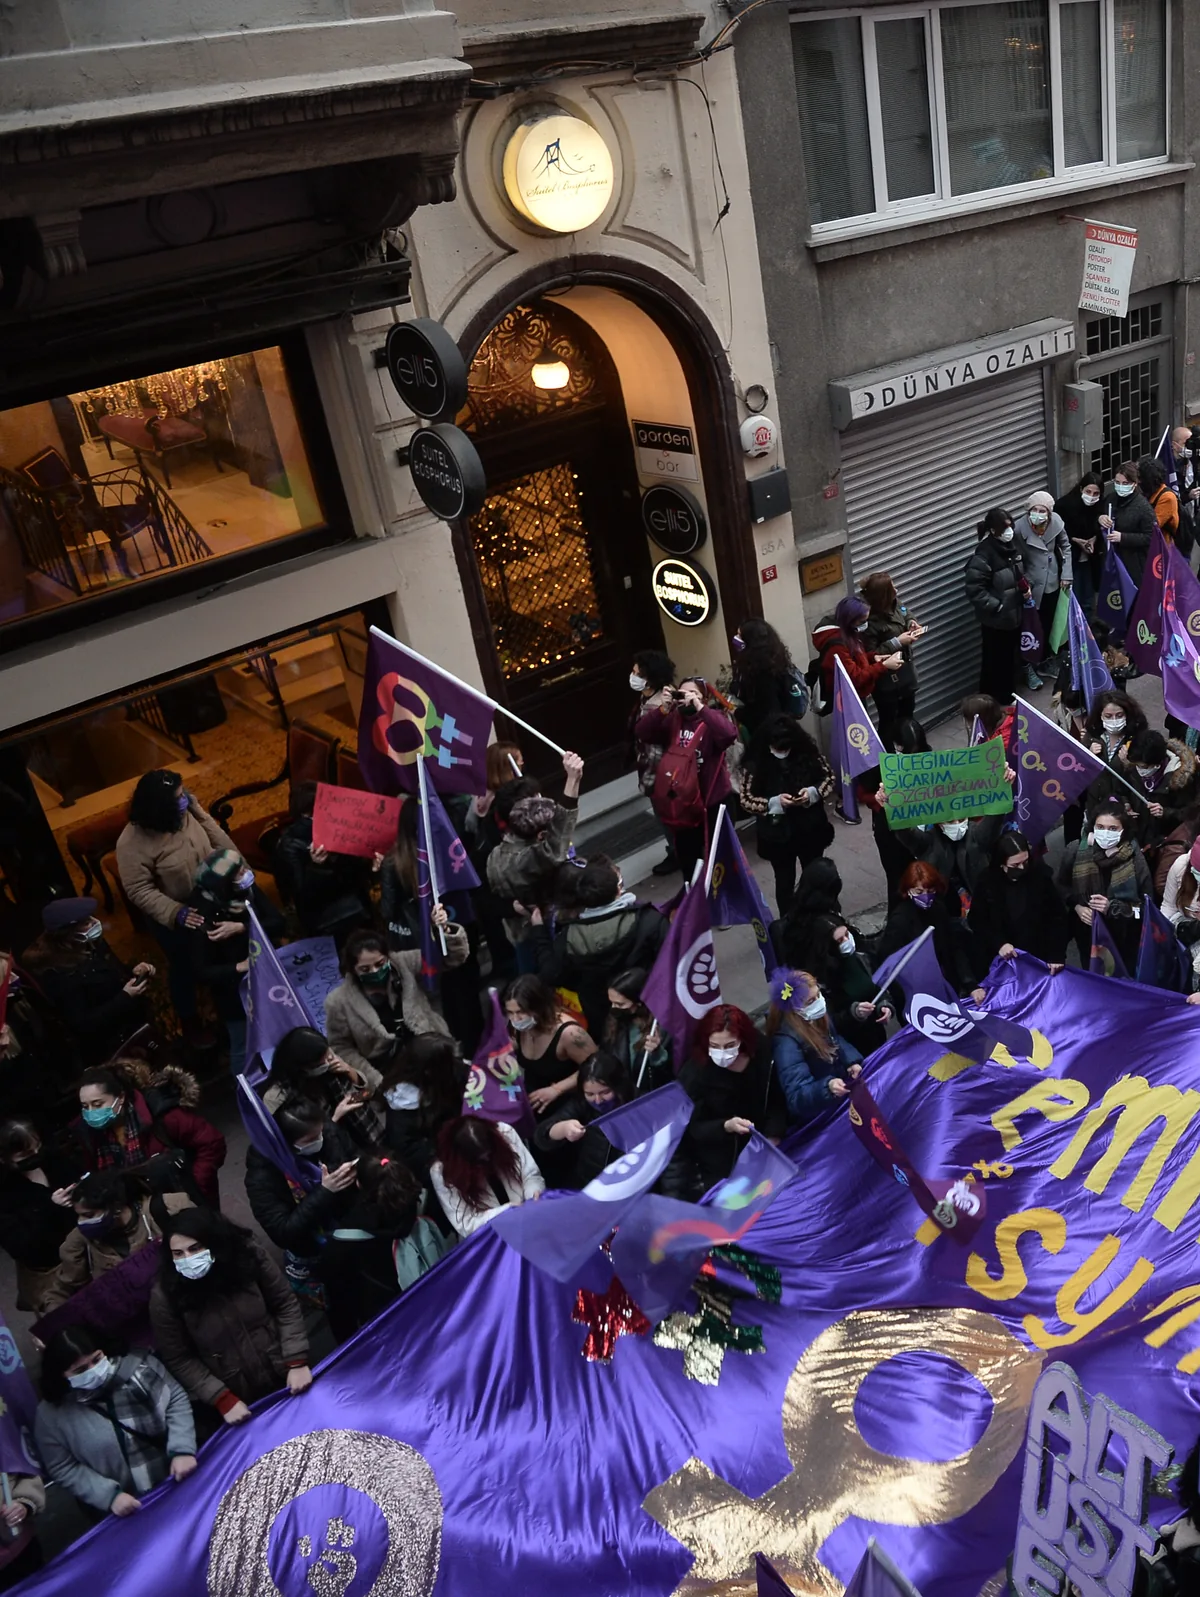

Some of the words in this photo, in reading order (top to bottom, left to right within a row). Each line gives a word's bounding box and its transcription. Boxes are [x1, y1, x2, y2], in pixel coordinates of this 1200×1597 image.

[1087, 262, 1106, 273] POSTER
[882, 362, 975, 407] DÜNYA
[986, 330, 1075, 374] OZALİT
[421, 443, 449, 469] SUITEL
[413, 459, 462, 494] BOSPHORUS
[663, 570, 694, 589] SUITEL
[765, 569, 775, 580] 55
